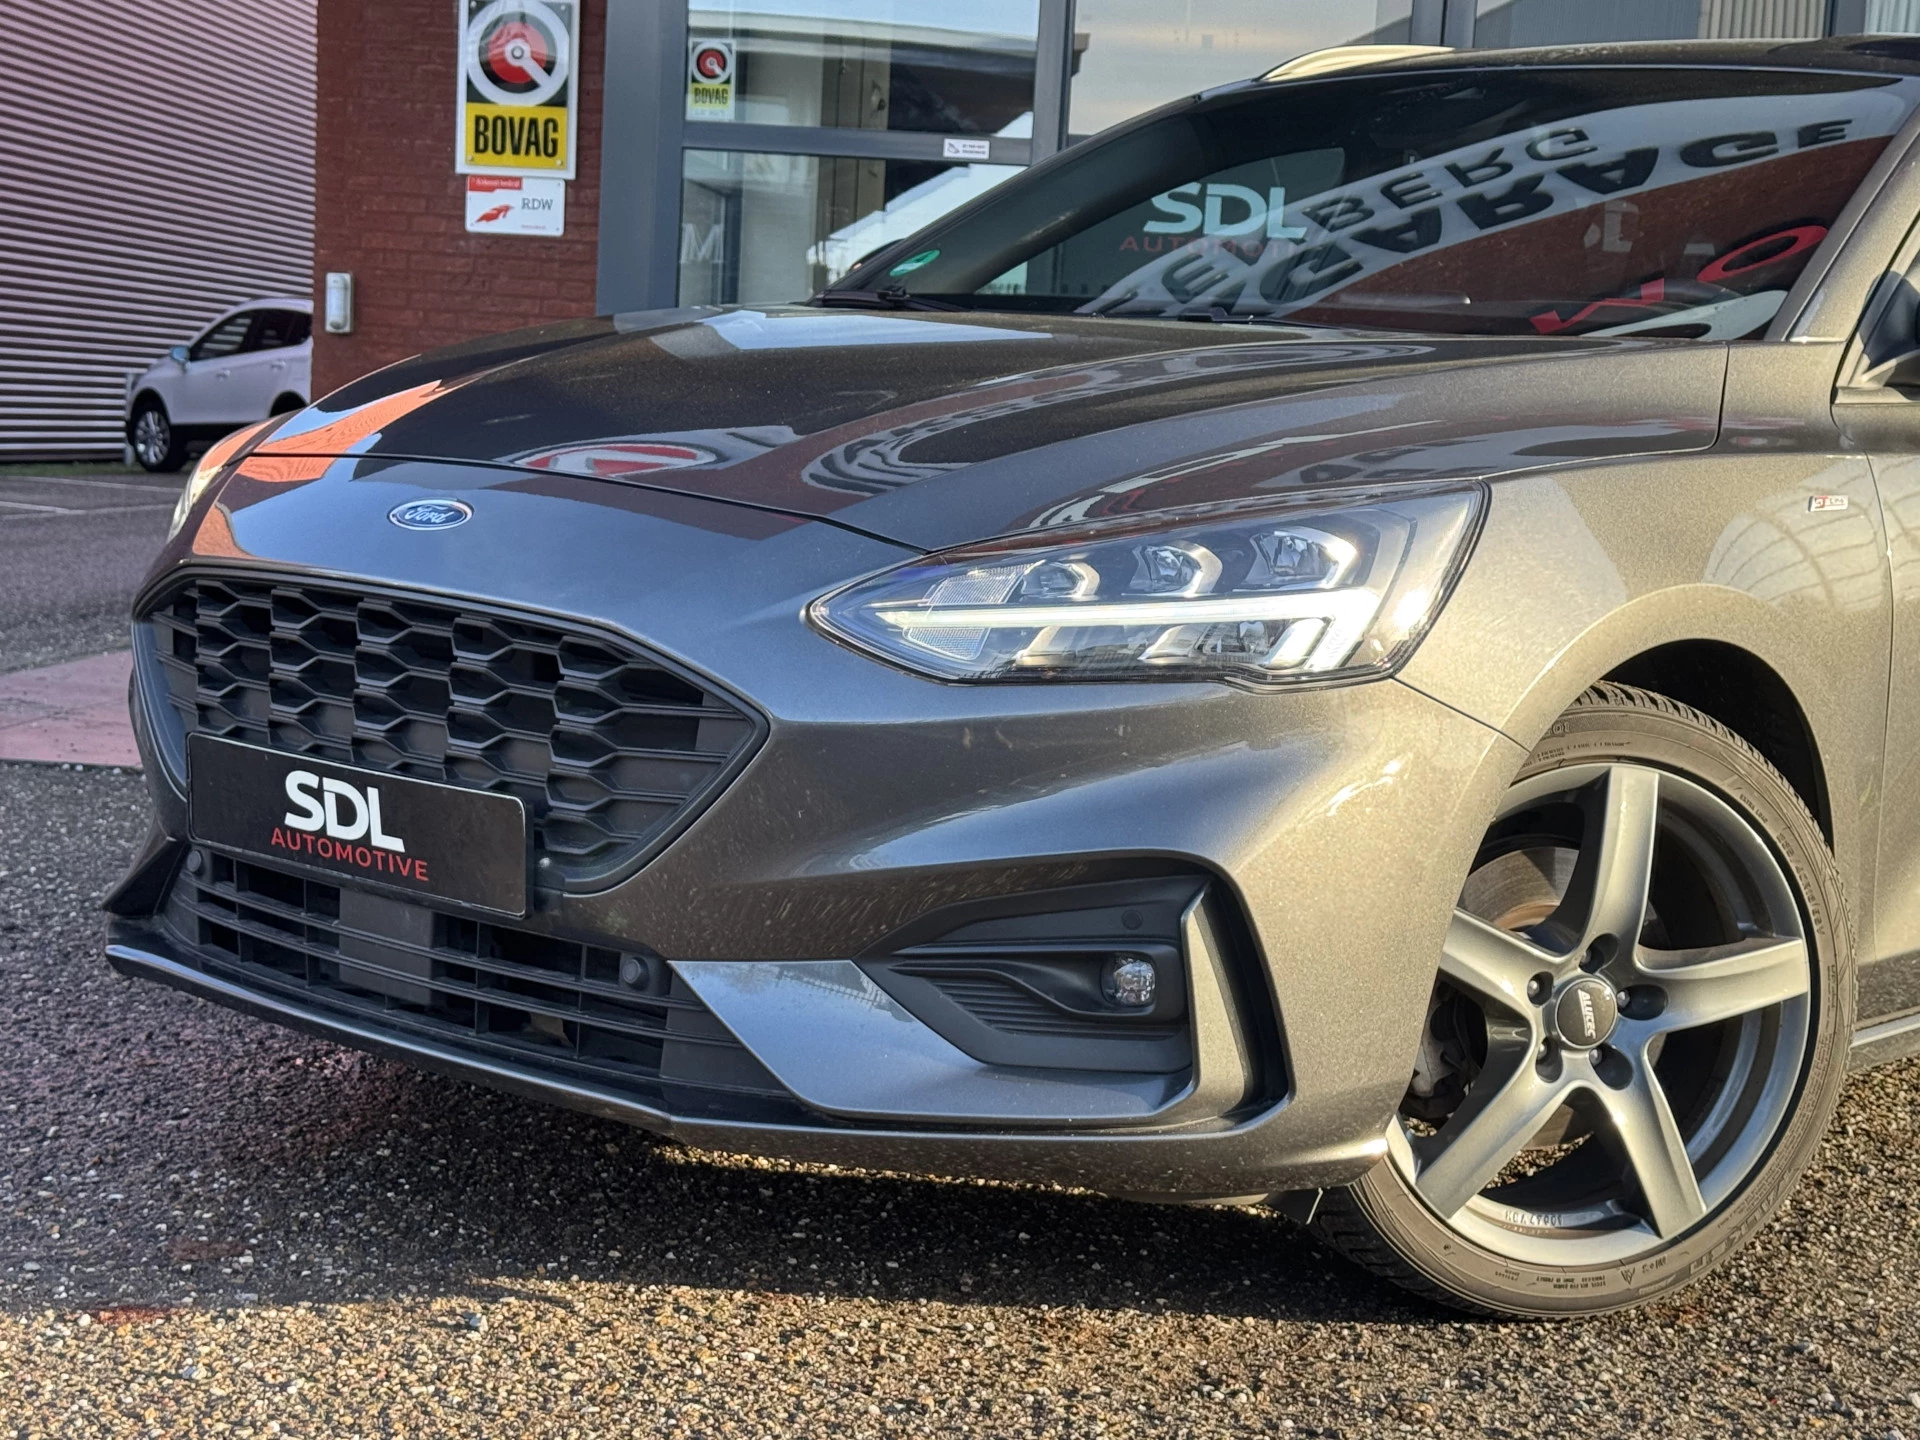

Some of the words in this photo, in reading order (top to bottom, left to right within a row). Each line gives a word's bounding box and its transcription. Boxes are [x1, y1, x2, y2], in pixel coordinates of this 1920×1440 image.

[694, 86, 729, 105] BOVAG
[474, 114, 559, 158] BOVAG
[521, 197, 554, 211] RDW
[1143, 181, 1308, 240] SDL
[404, 504, 455, 524] Ford
[284, 769, 406, 853] SDL
[270, 827, 430, 882] AUTOMOTIVE
